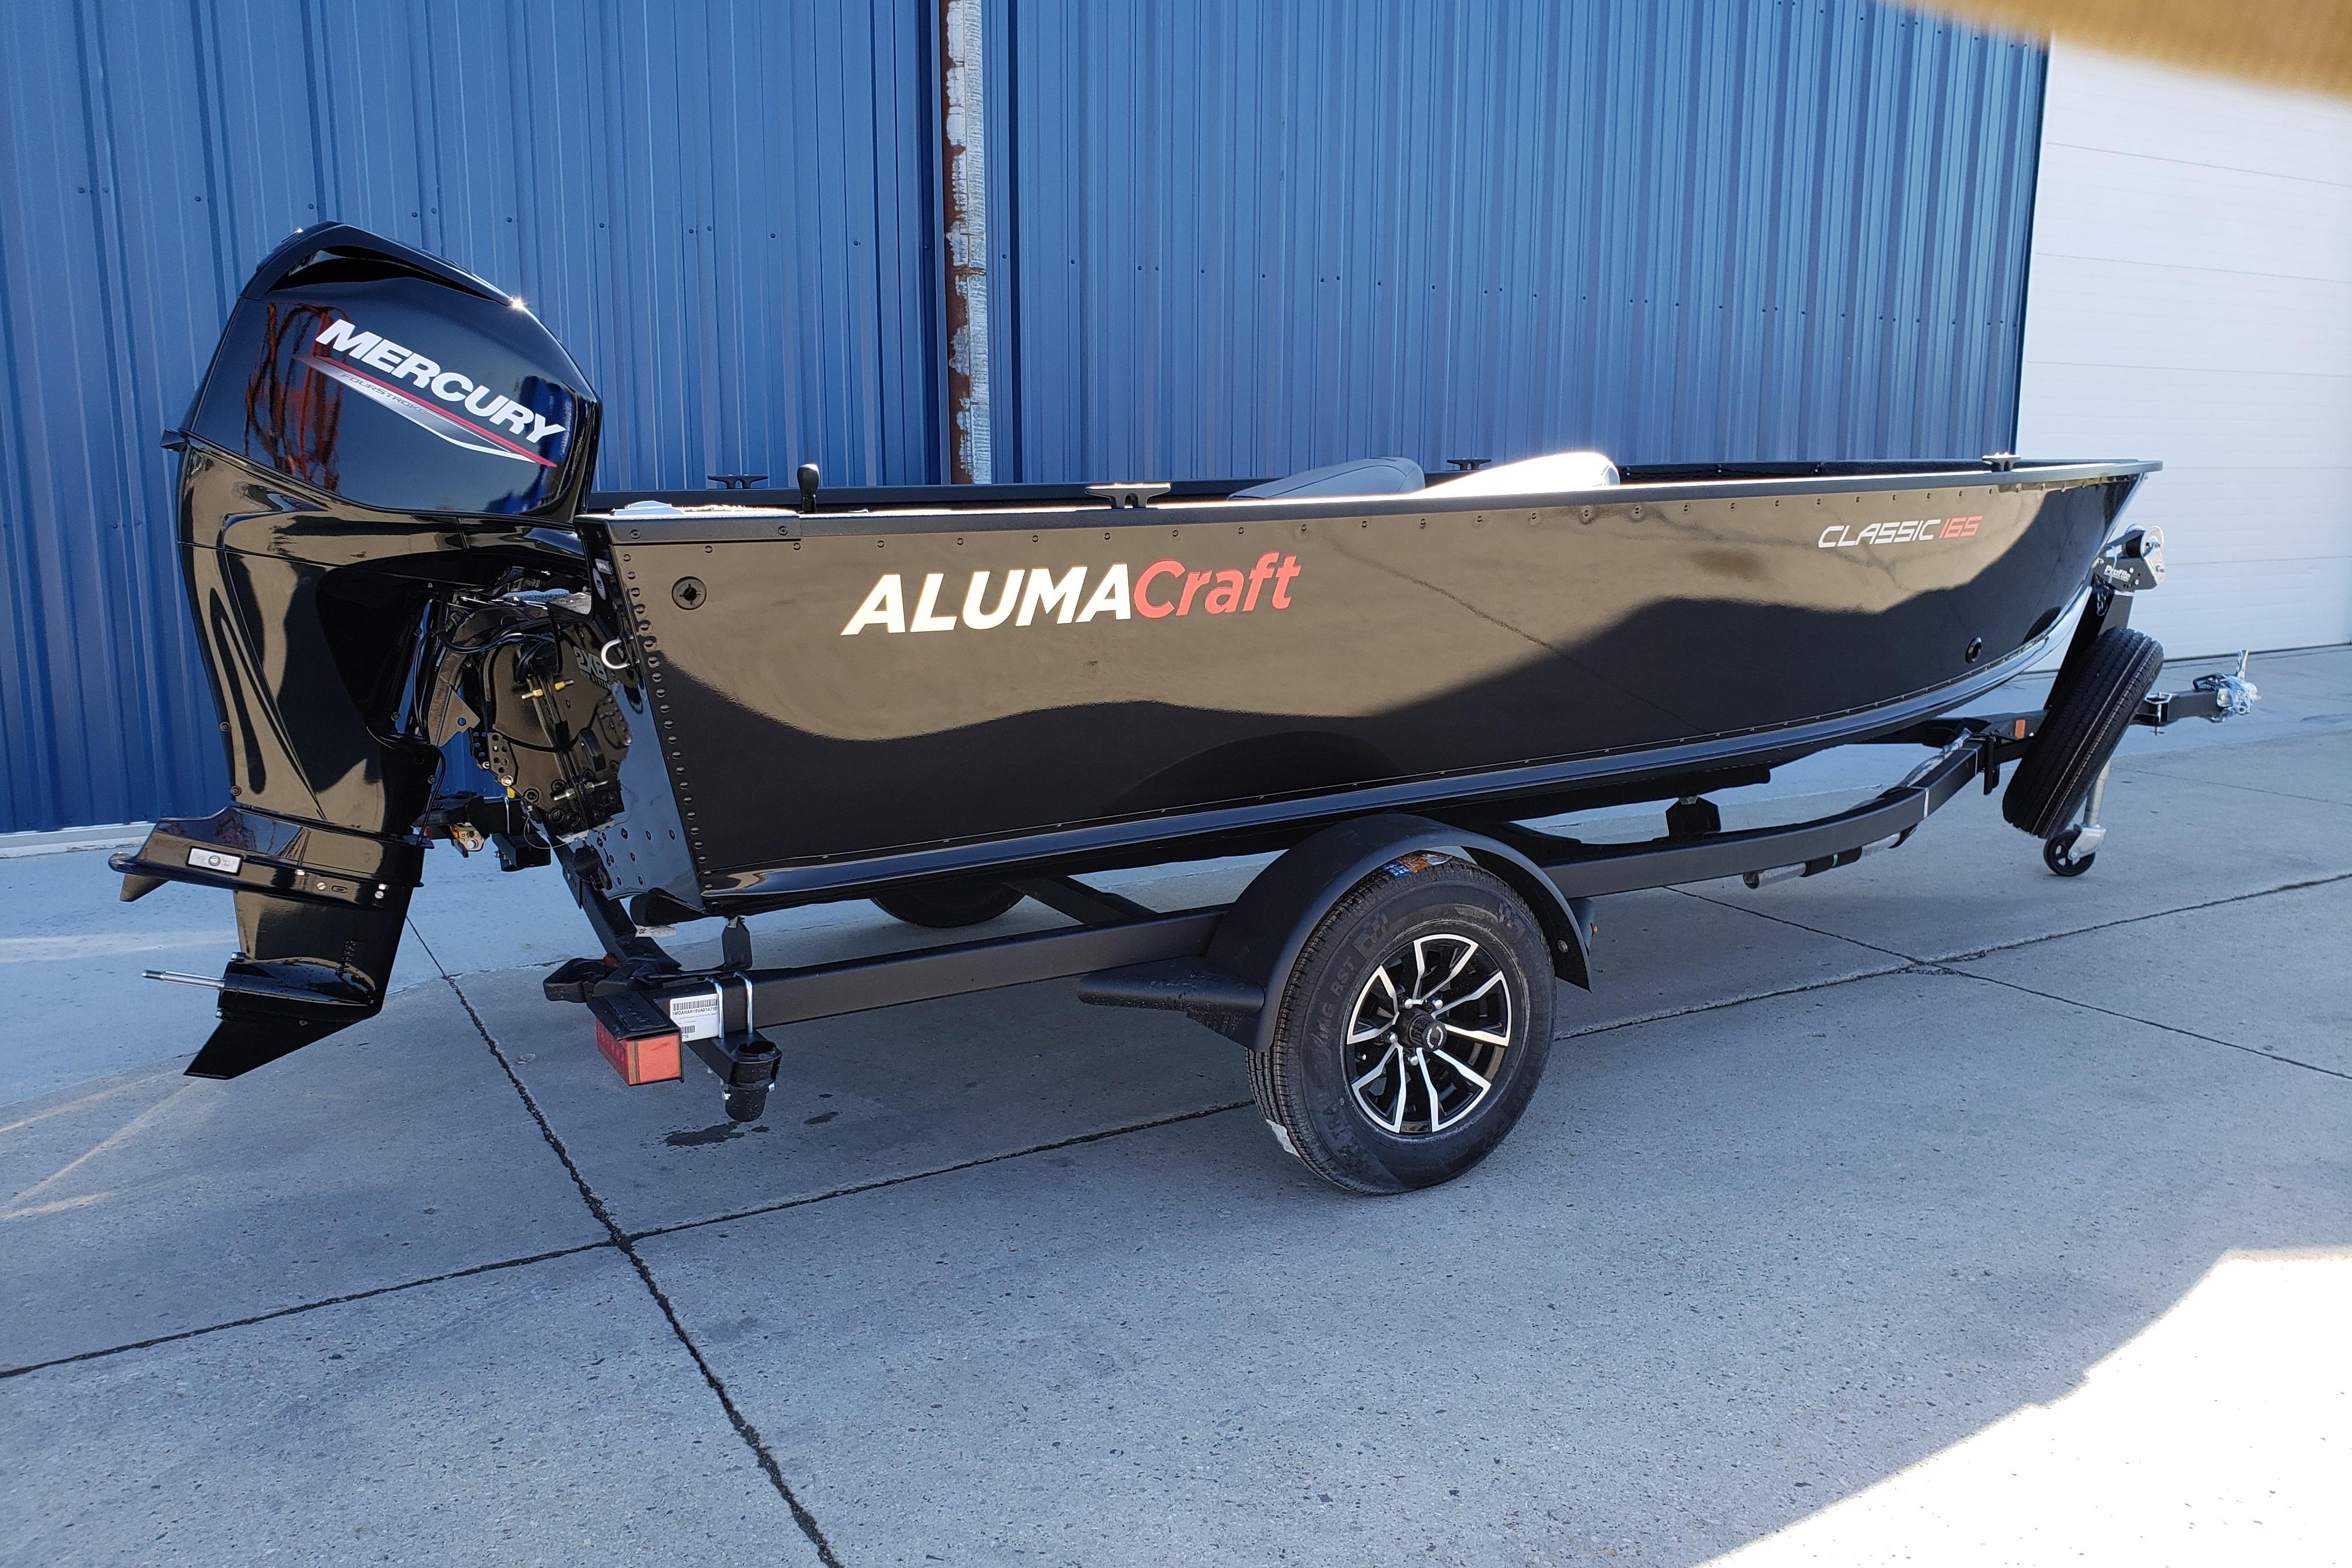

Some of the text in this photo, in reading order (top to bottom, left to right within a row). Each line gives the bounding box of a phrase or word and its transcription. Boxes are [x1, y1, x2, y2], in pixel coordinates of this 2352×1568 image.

[316, 319, 566, 443] MERCURY
[340, 372, 428, 414] FOURSTROKE
[1818, 516, 1983, 548] CLASSIC 165
[840, 551, 1302, 636] ALUMACraft
